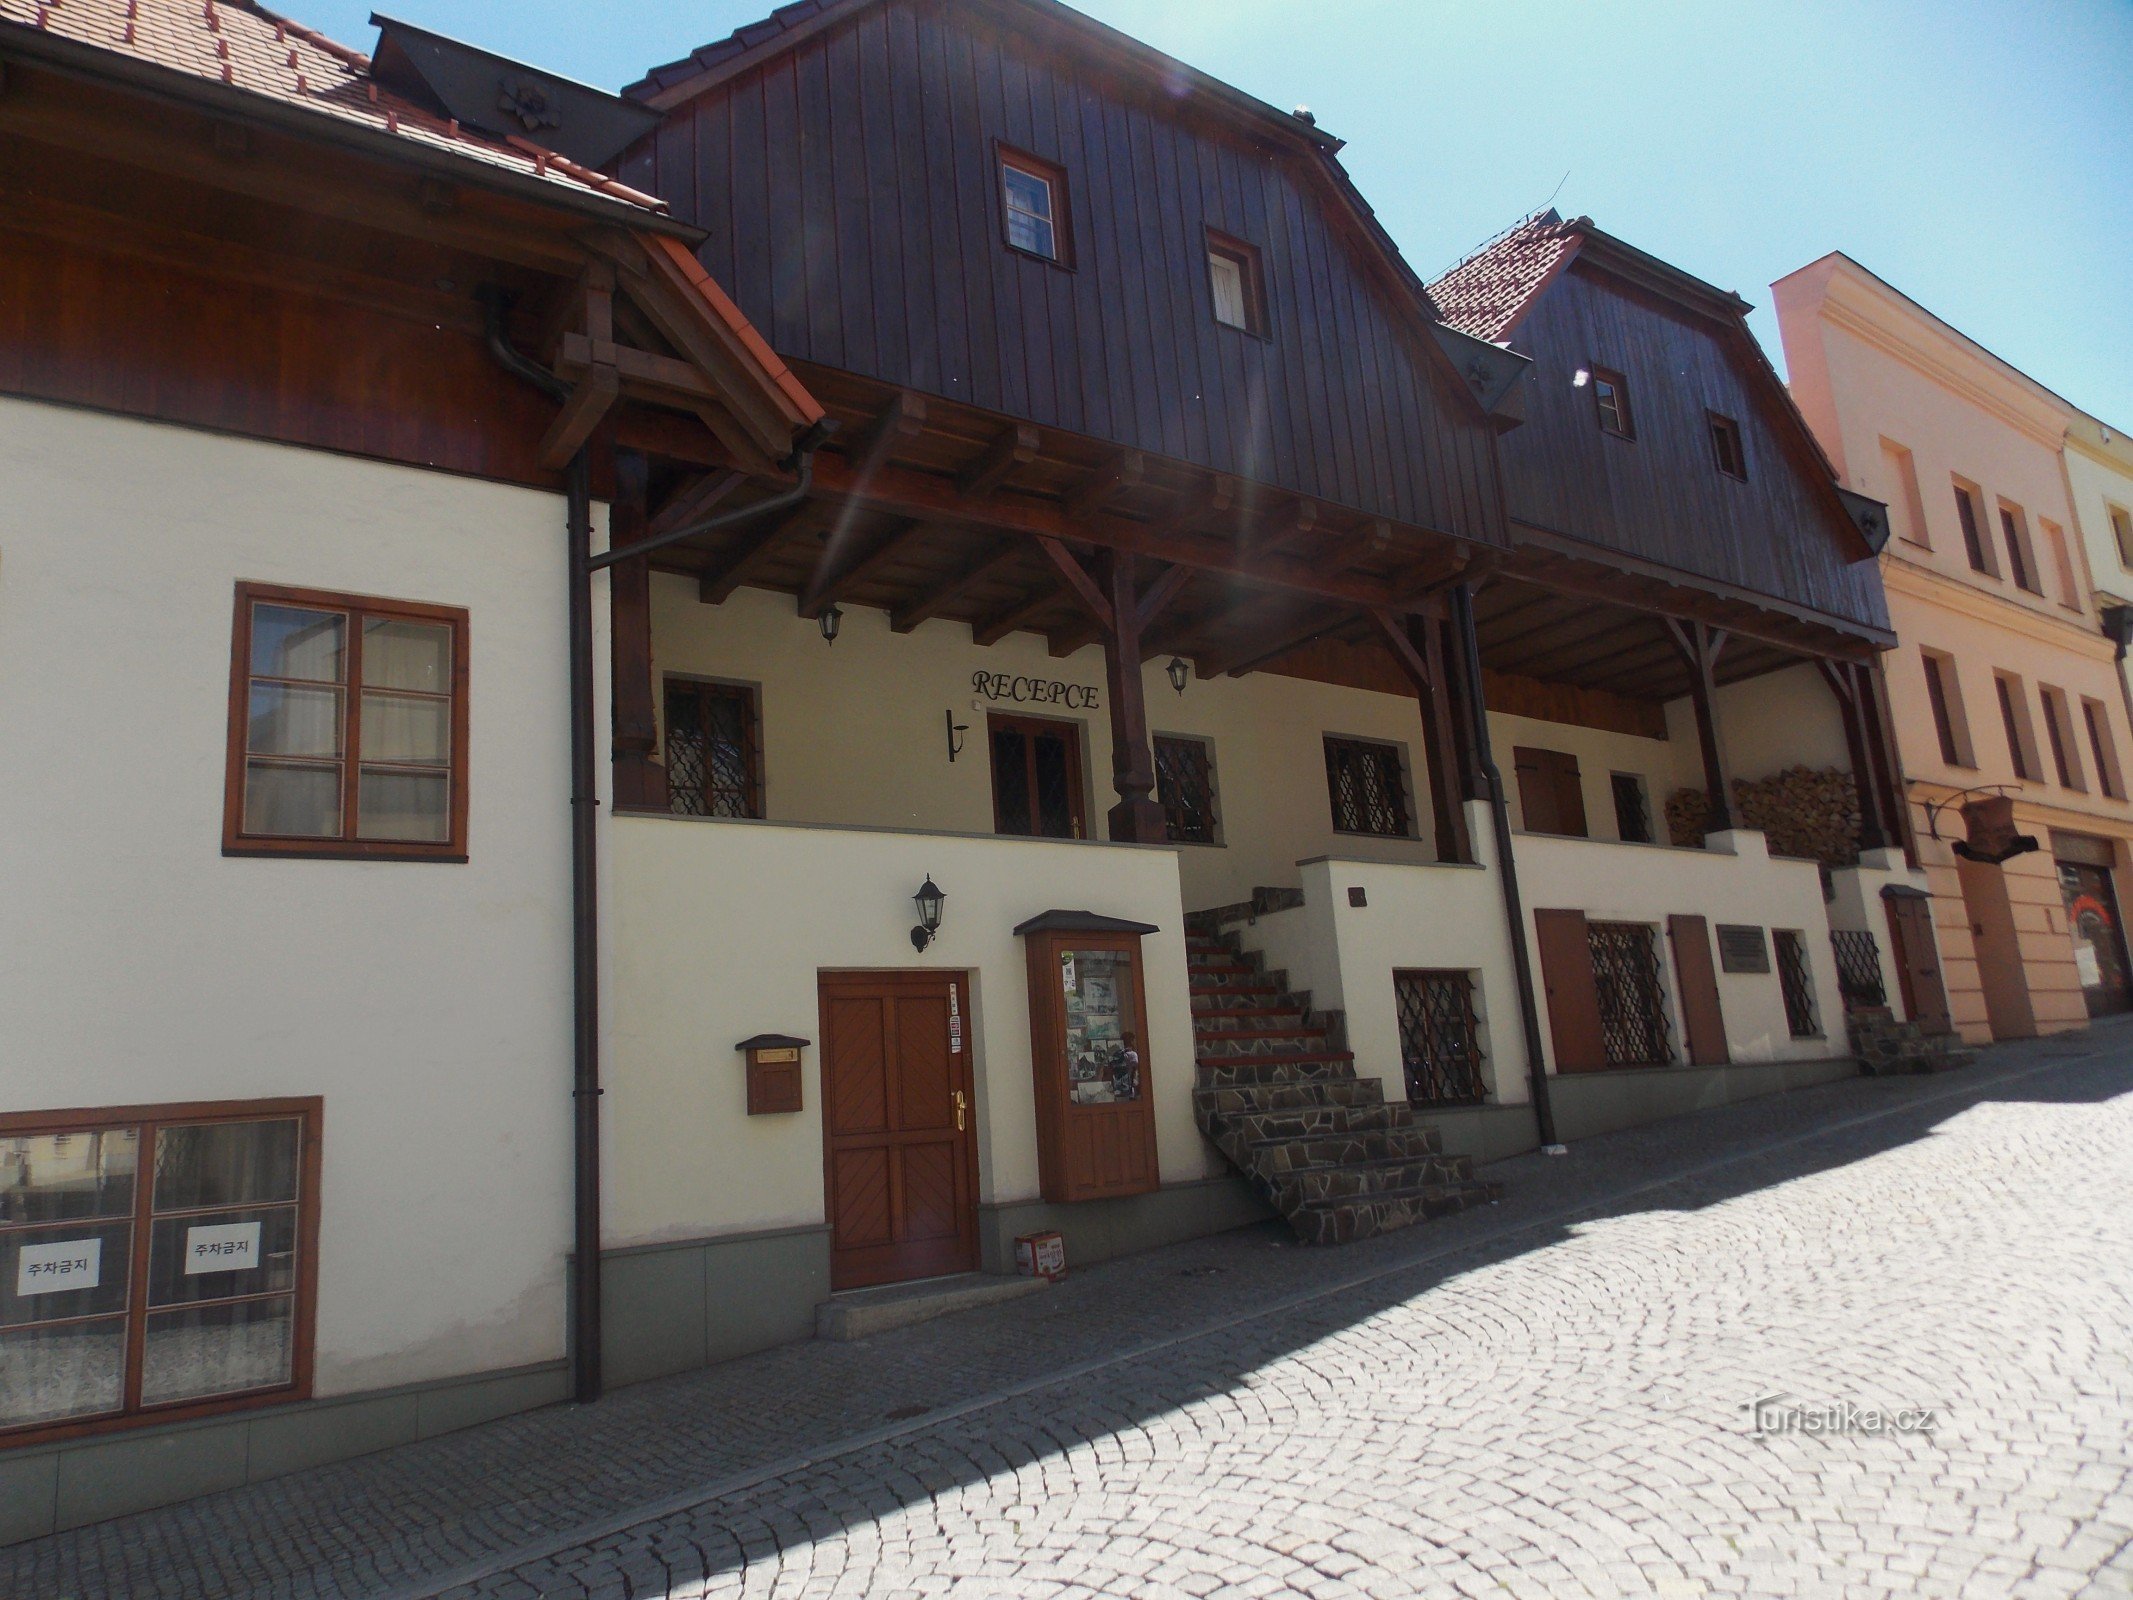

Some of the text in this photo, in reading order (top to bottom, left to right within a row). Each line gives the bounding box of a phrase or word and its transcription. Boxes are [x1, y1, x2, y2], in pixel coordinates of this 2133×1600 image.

[972, 670, 1099, 709] RECEPCE
[195, 1240, 248, 1256] 주차금지
[28, 1258, 87, 1277] 주차금지
